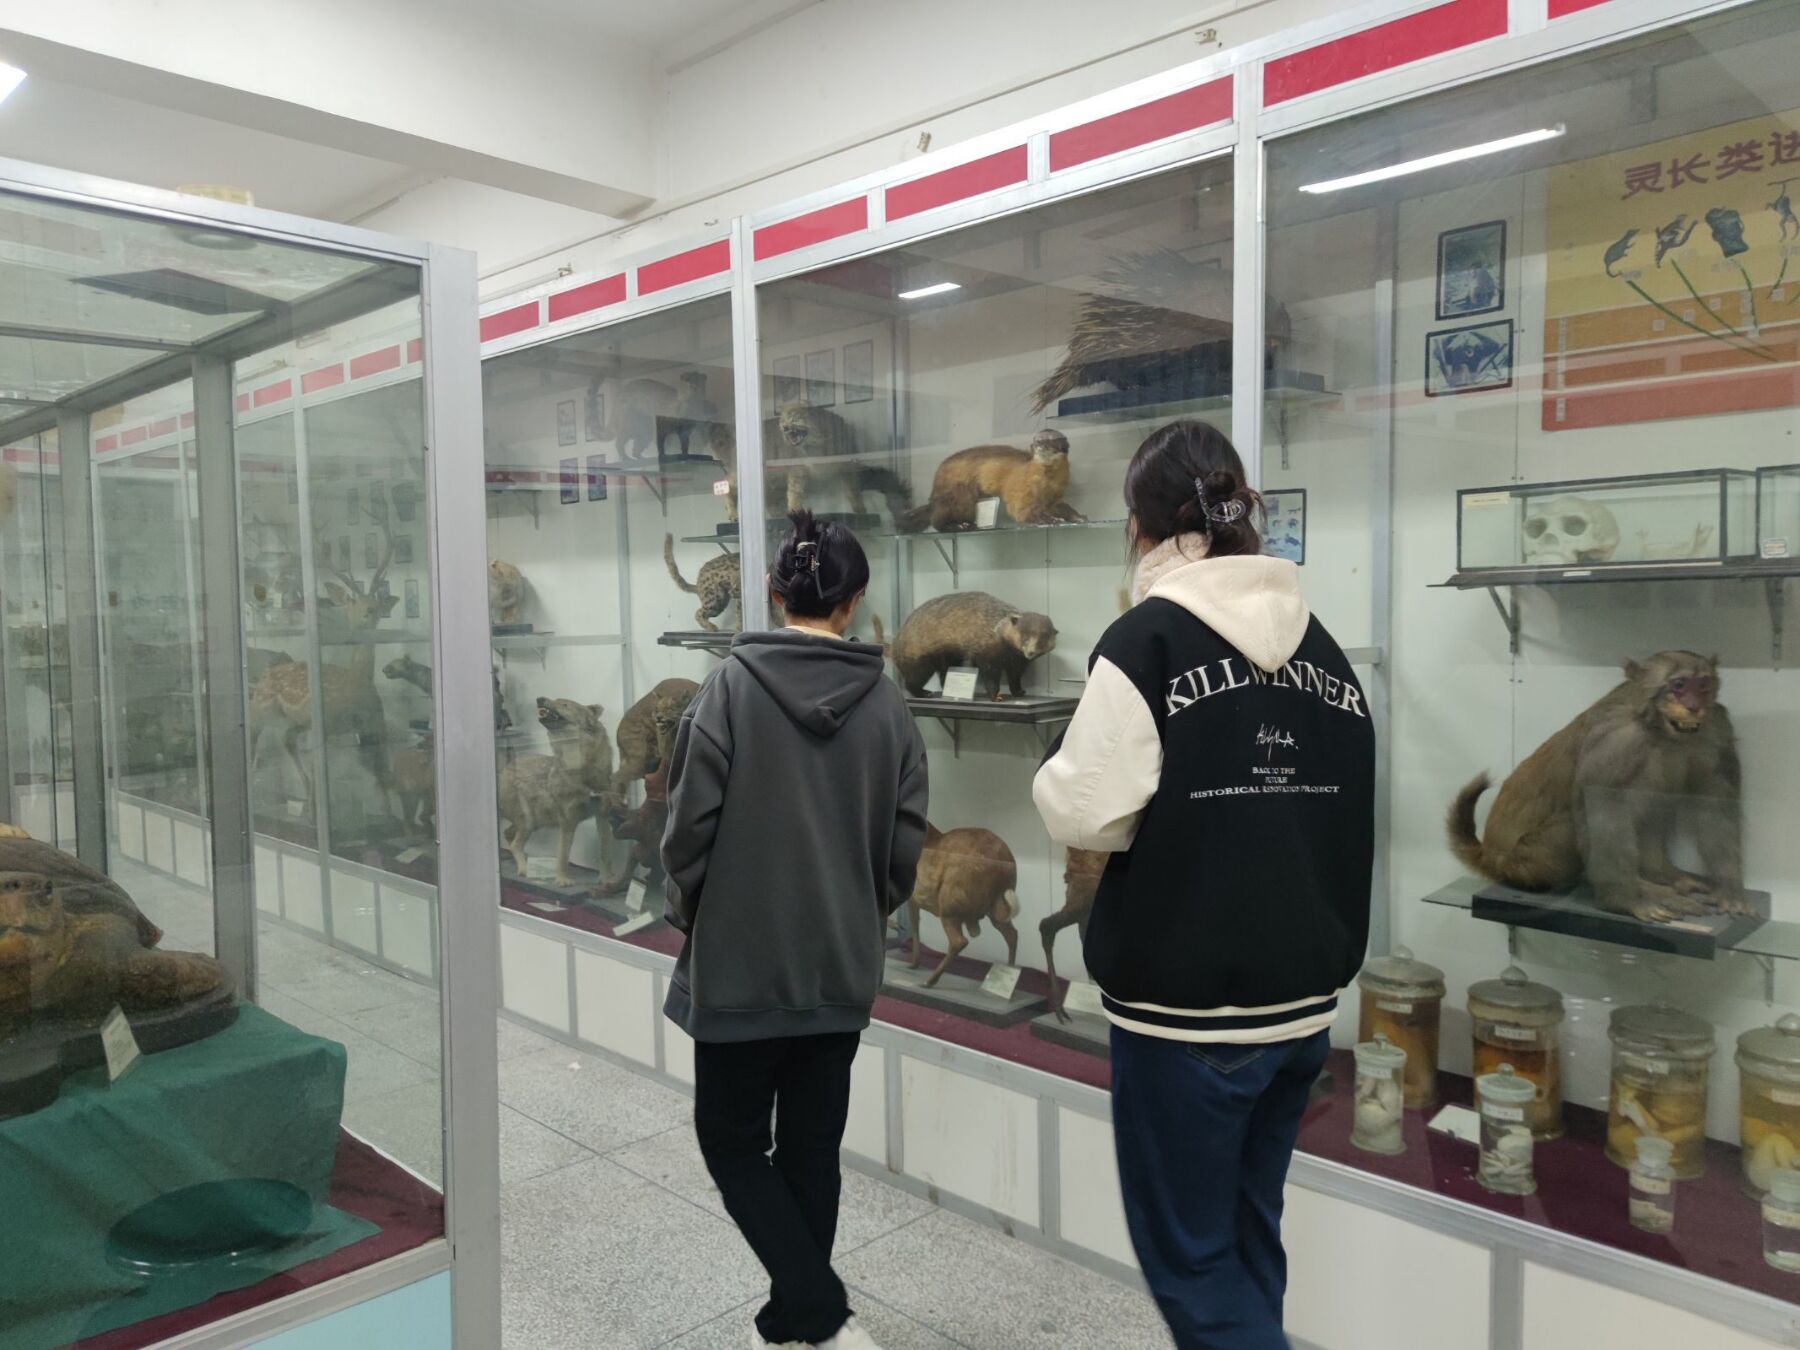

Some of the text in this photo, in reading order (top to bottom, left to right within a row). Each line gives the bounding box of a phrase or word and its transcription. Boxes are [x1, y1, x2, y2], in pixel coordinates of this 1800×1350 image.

[1280, 767, 1296, 775] THE
[1190, 786, 1261, 799] HISTORICAL
[1300, 785, 1340, 794] PROJECT
